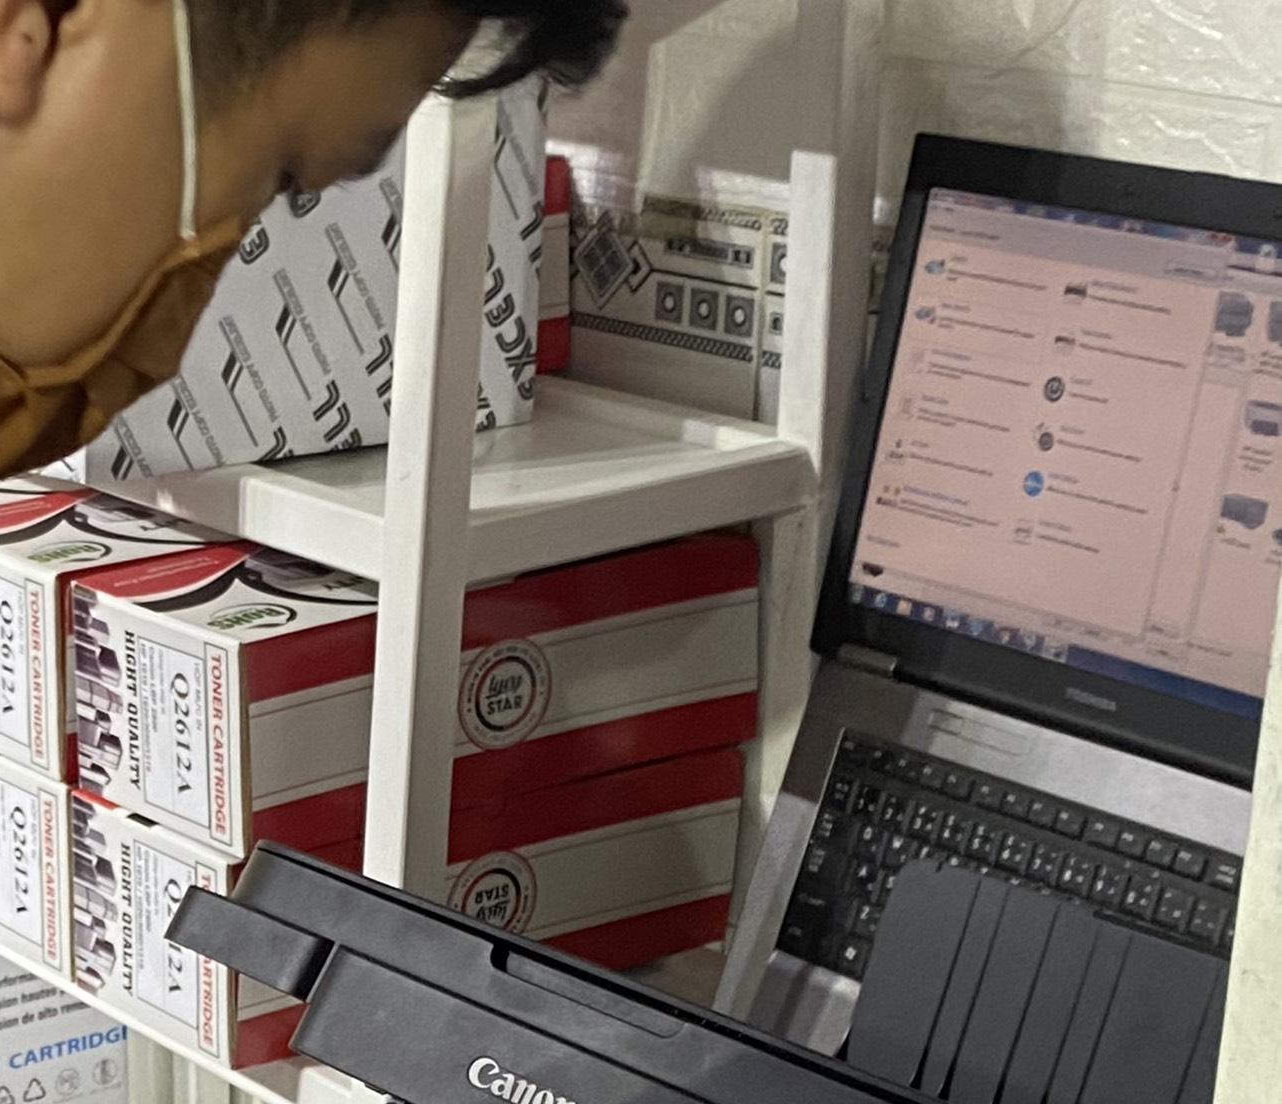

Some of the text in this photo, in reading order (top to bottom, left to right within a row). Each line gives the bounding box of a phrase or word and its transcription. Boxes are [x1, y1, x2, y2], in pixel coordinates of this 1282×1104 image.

[30, 590, 44, 760] TONER CARTRIDGE
[124, 630, 142, 790] HIGHT QUALITY
[170, 672, 192, 795] Q2612A
[487, 695, 523, 716] STAR
[211, 653, 227, 836] TONER CARTRIDGE
[10, 806, 29, 914] Q2612A
[43, 800, 57, 961] TONER CARTRIDGE
[120, 842, 134, 997] HIGHT QUALITY
[475, 884, 510, 904] STAR
[164, 878, 184, 994] Q212A
[21, 1011, 35, 1024] de
[202, 955, 214, 1047] ARTRIDGE
